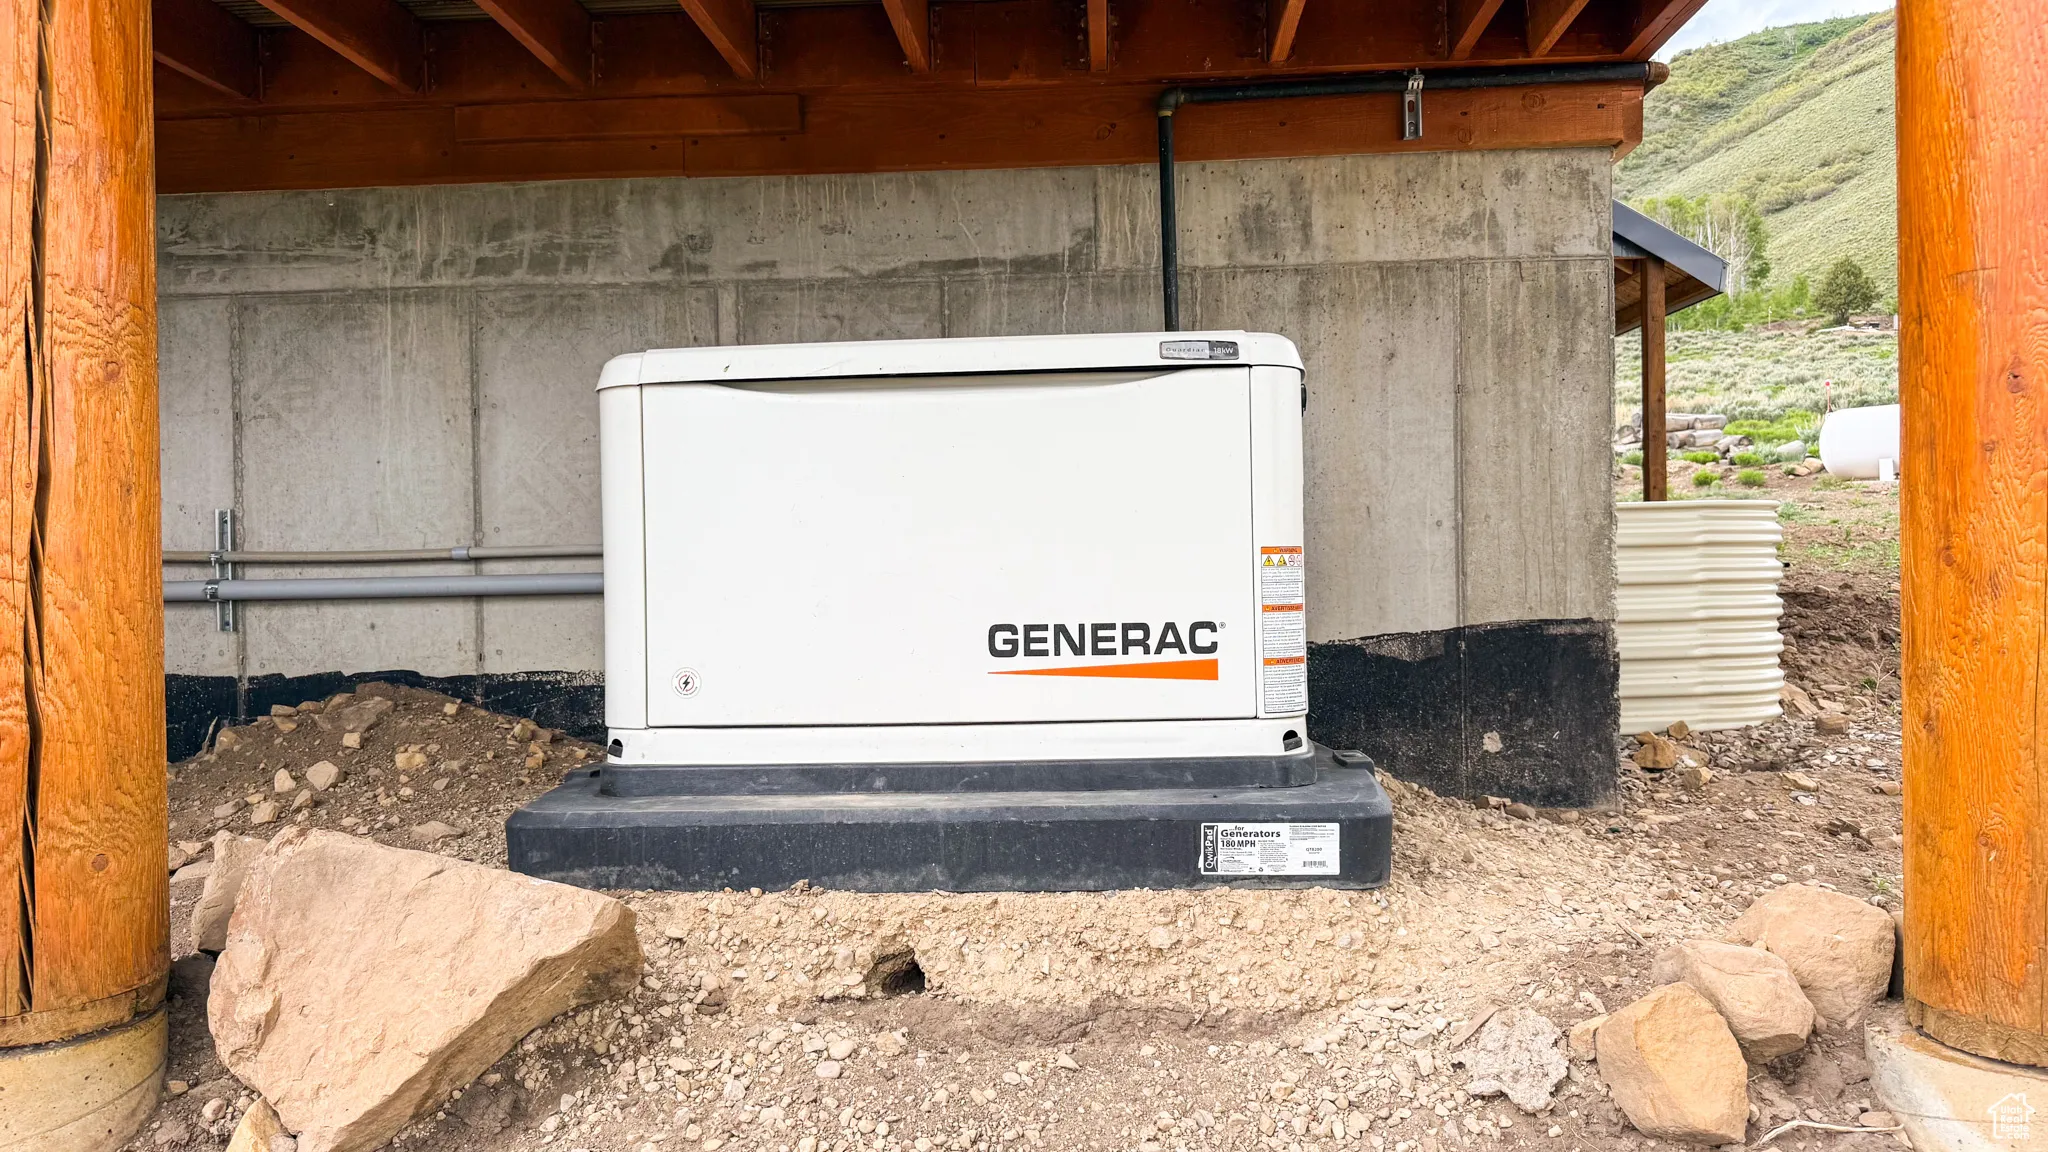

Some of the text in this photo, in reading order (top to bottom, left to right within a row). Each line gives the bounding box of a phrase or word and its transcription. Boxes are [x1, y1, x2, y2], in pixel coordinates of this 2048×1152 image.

[988, 621, 1218, 658] GENERAC
[1220, 829, 1281, 838] Generators
[1220, 840, 1256, 848] 180 MPH
